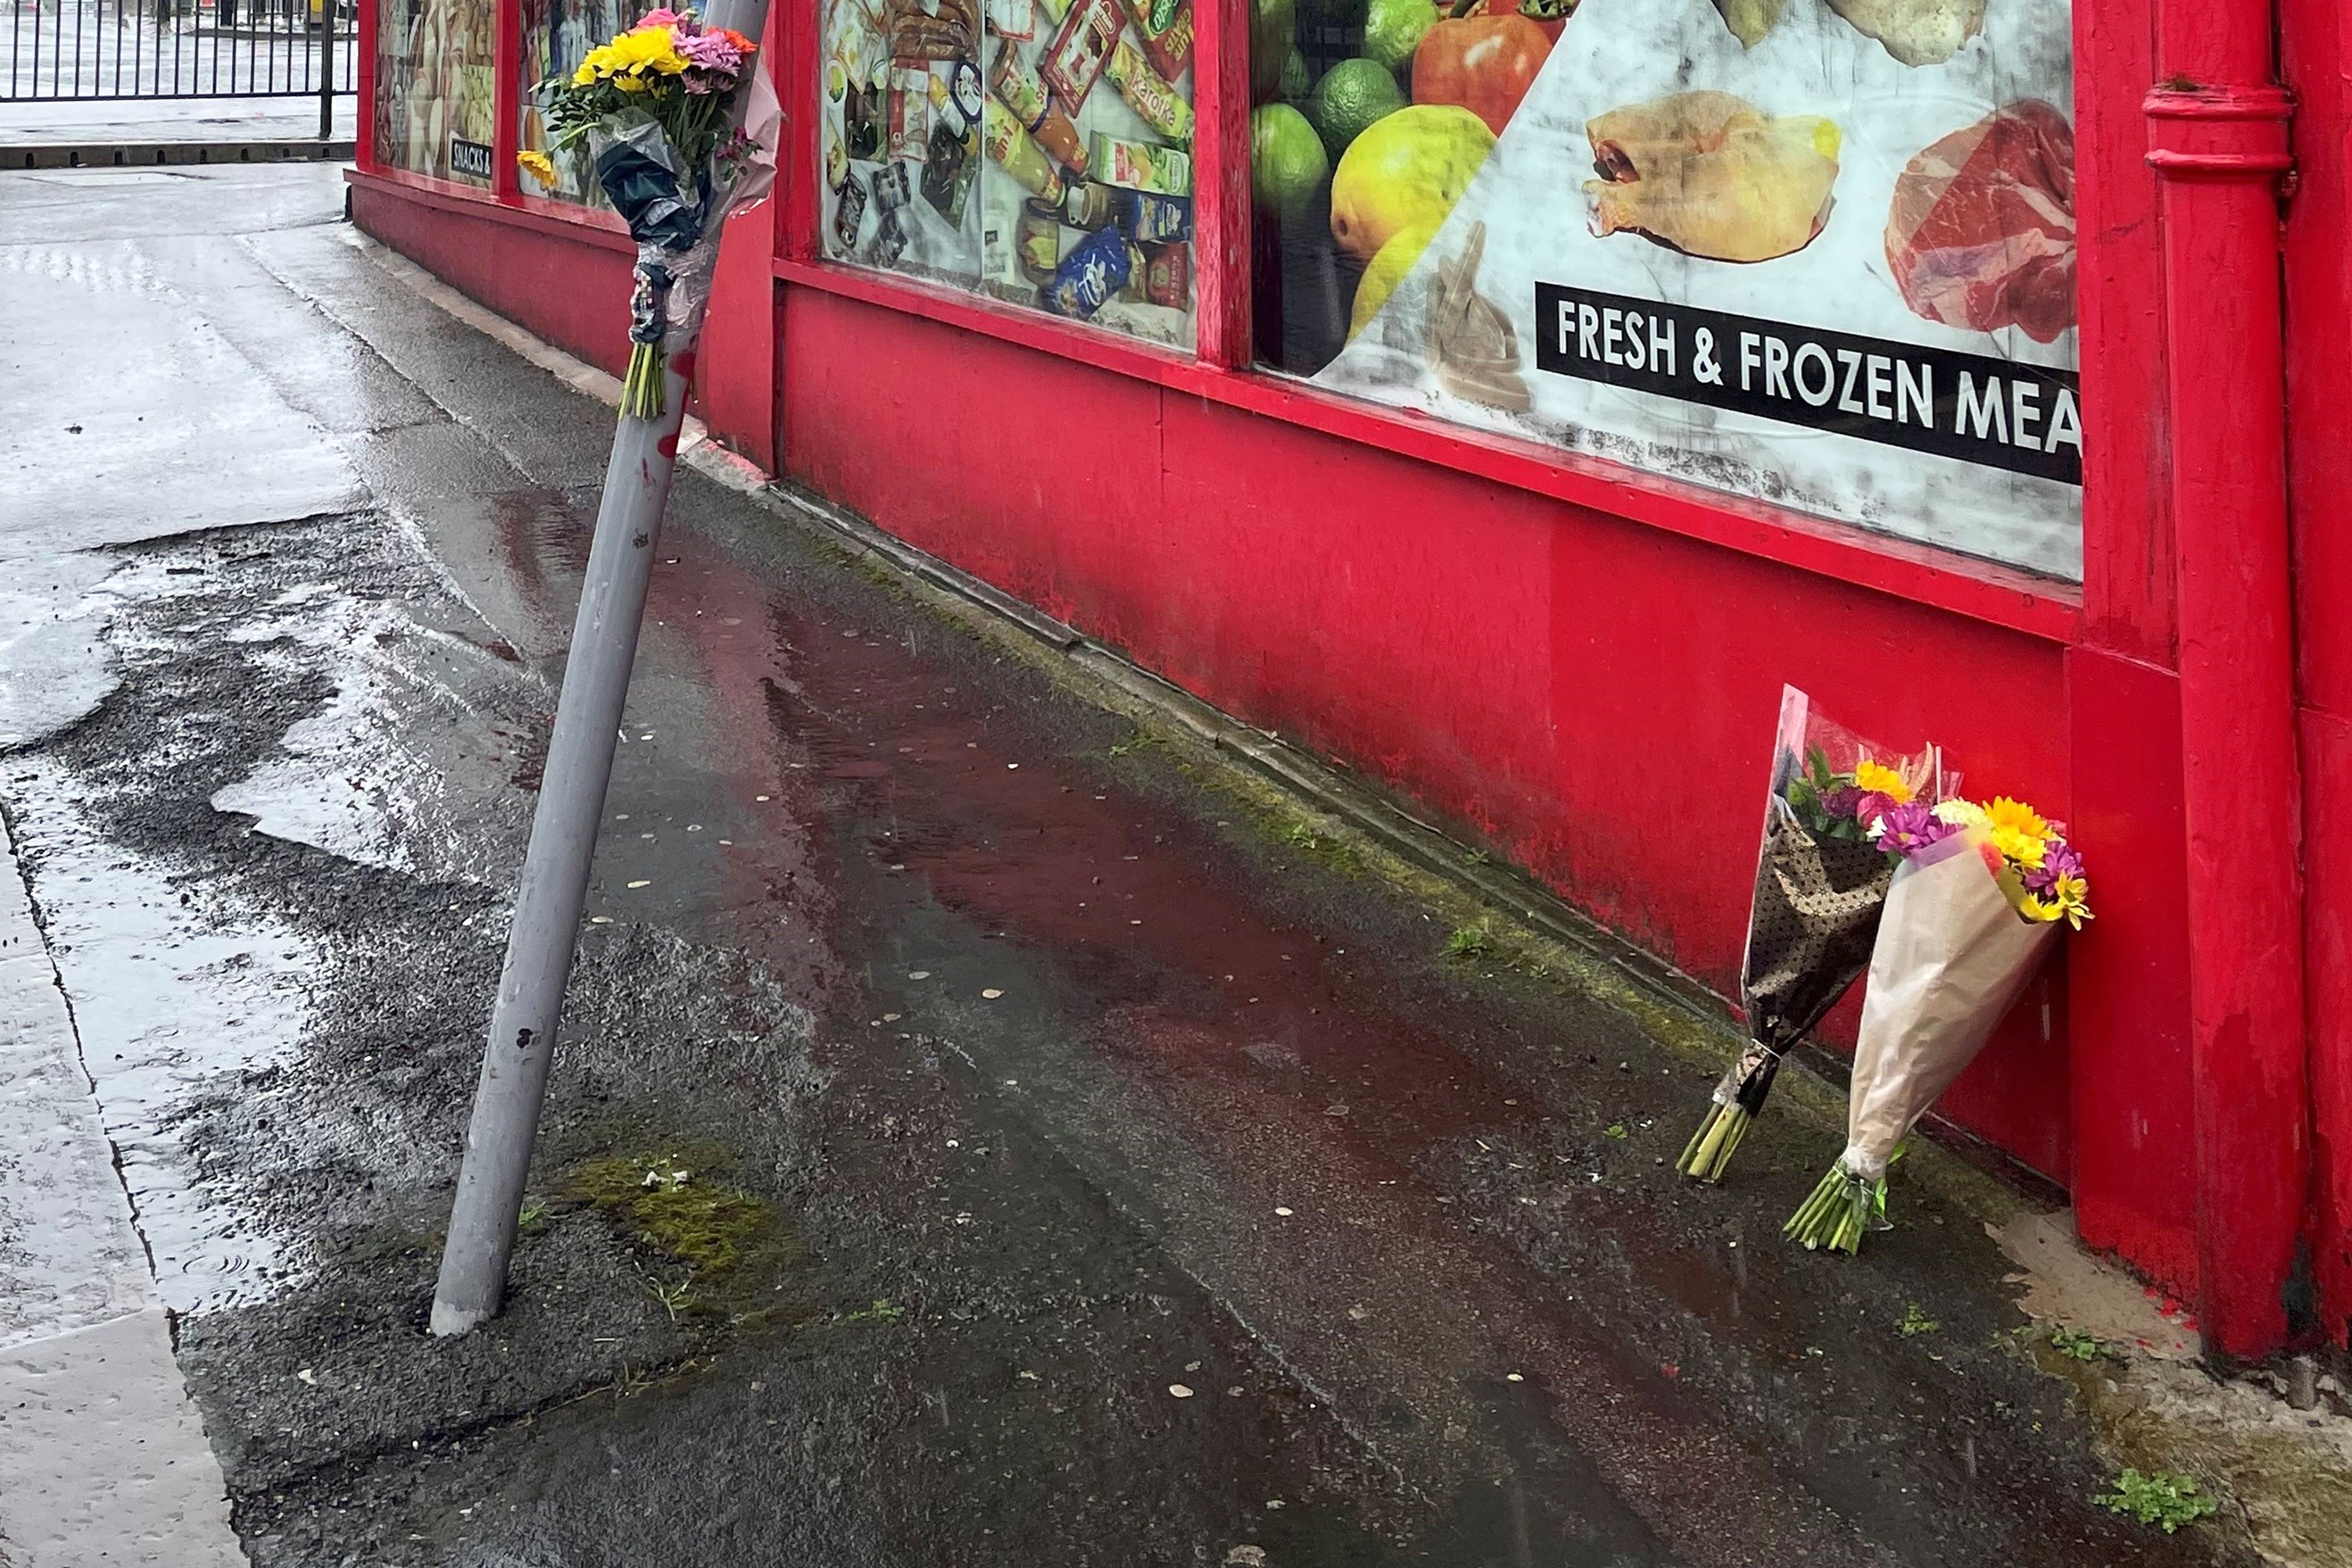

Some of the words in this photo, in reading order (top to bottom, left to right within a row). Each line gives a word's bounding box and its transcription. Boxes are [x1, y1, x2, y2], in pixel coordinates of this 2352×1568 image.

[1558, 299, 1676, 376] FRESH
[1693, 326, 1724, 386] &
[1740, 331, 1934, 429] FROZEN
[1955, 370, 2083, 459] MEA
